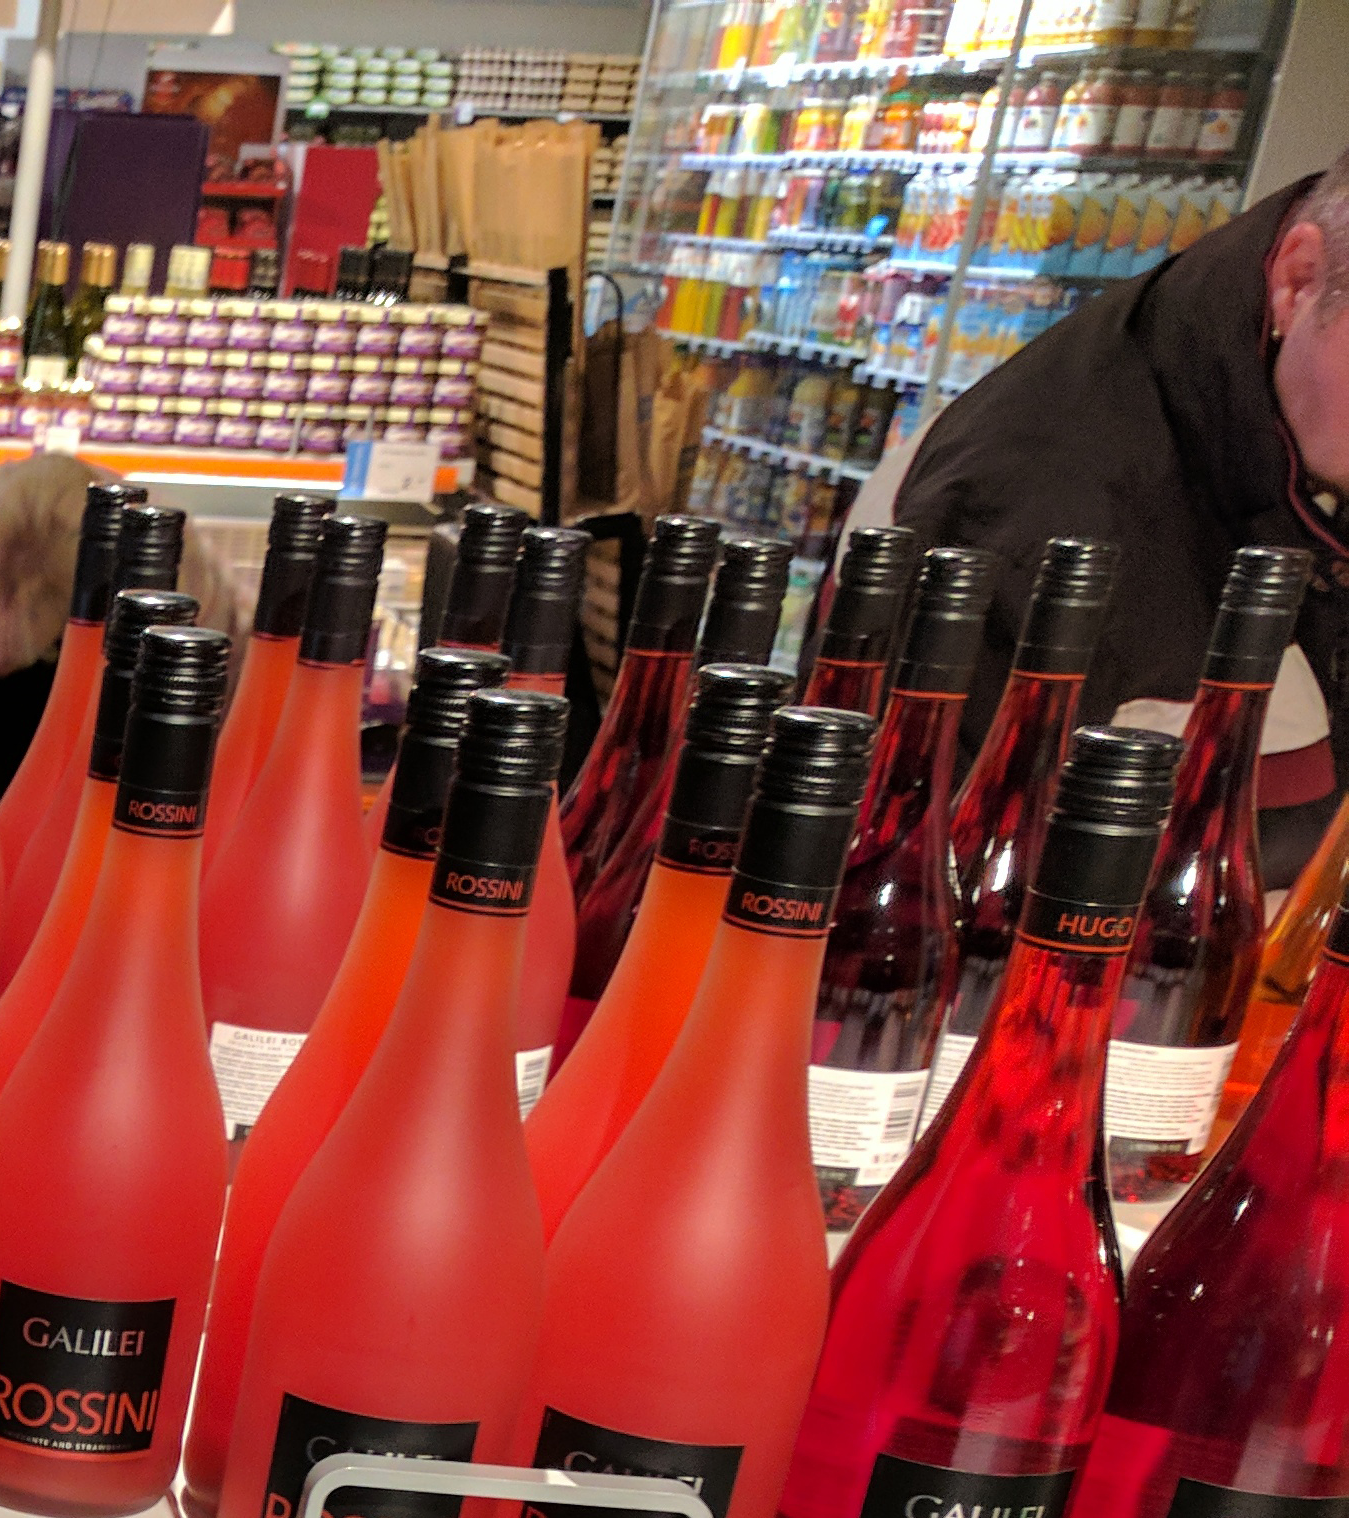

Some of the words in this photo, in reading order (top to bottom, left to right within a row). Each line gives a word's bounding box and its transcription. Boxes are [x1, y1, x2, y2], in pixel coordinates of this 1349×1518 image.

[128, 800, 197, 824] ROSSINI
[446, 871, 523, 901] ROSSINI
[741, 891, 823, 922] ROSSINI
[1057, 913, 1134, 939] HUGO
[22, 1317, 145, 1357] GALILEI
